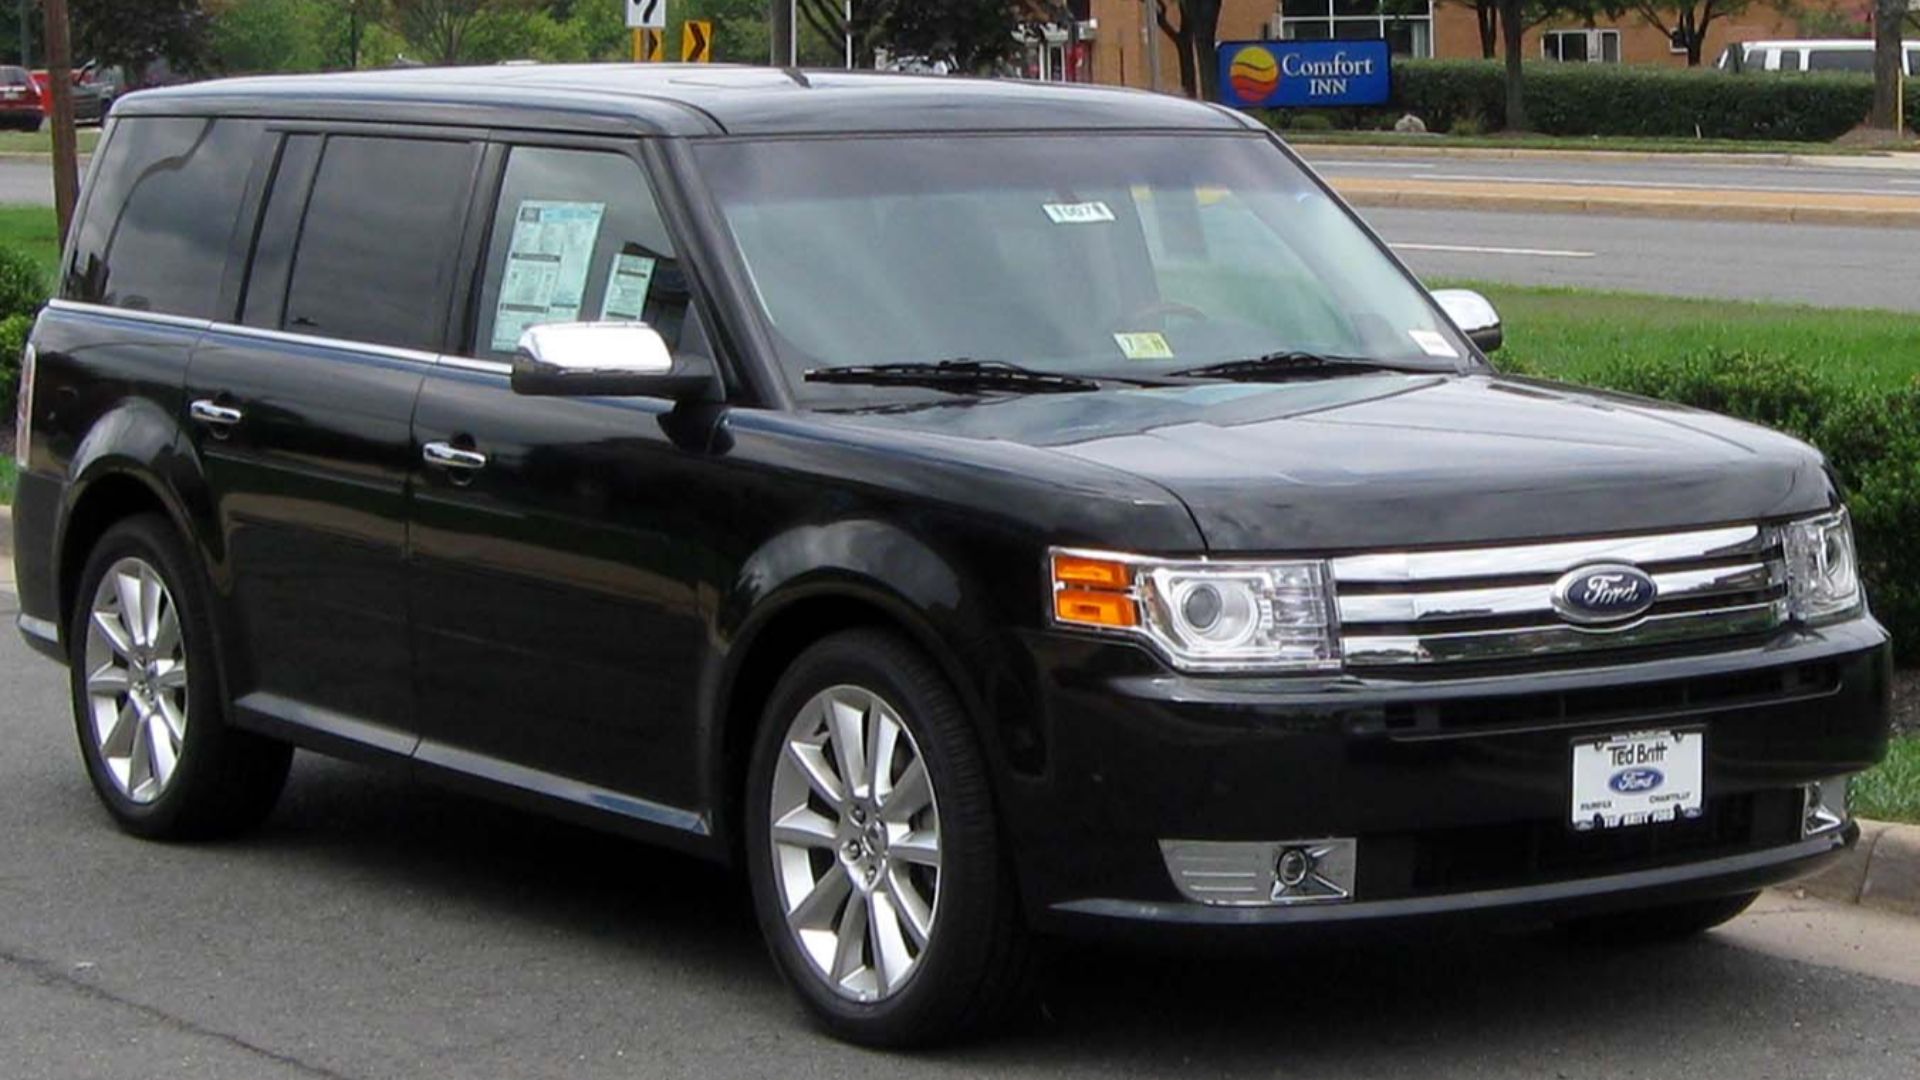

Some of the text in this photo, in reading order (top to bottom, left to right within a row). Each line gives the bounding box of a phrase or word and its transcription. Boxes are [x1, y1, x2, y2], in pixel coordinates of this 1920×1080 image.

[1282, 52, 1373, 77] Comfort
[1310, 79, 1347, 96] INN
[1584, 574, 1639, 604] Ford
[1607, 742, 1668, 766] Ted Britt
[1618, 771, 1653, 790] Ford
